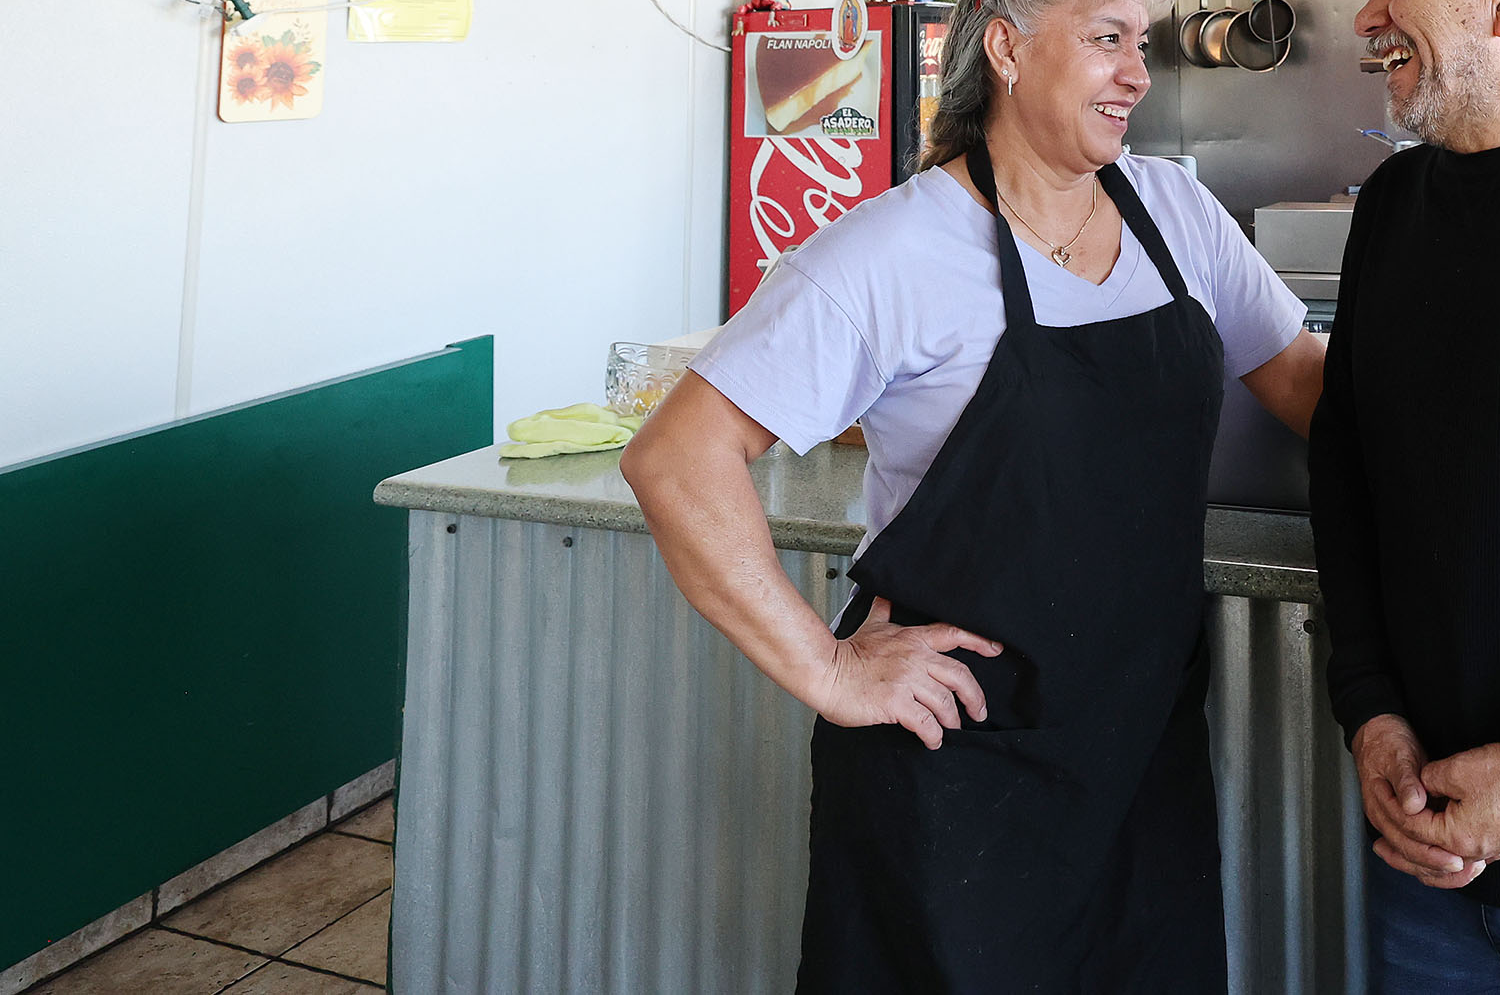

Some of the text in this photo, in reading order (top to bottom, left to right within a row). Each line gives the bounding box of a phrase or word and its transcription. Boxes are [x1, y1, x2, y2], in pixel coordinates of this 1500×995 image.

[767, 39, 831, 49] FLAN NAPOLI
[842, 108, 853, 116] EL
[823, 117, 871, 128] ASADERO
